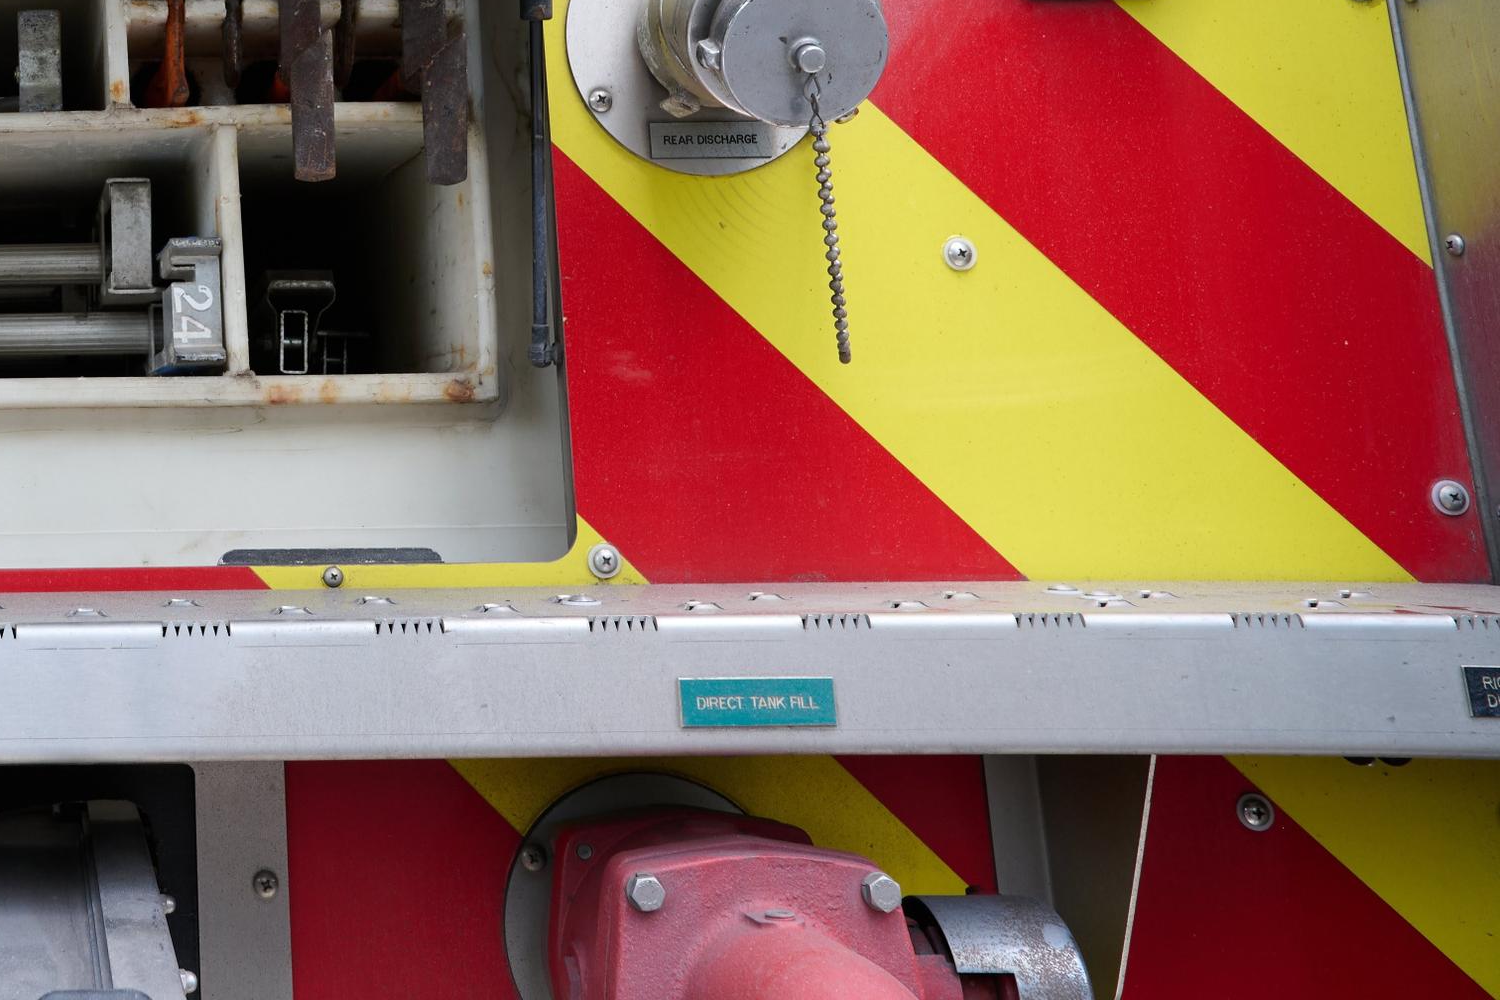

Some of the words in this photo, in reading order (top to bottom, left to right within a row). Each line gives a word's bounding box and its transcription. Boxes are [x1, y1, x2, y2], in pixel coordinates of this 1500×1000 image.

[663, 135, 694, 145] REAR
[697, 134, 758, 145] DISCHARGE
[173, 285, 213, 344] 24
[696, 696, 744, 710] DIRECT
[750, 696, 787, 710] TANK
[790, 695, 820, 709] FILL
